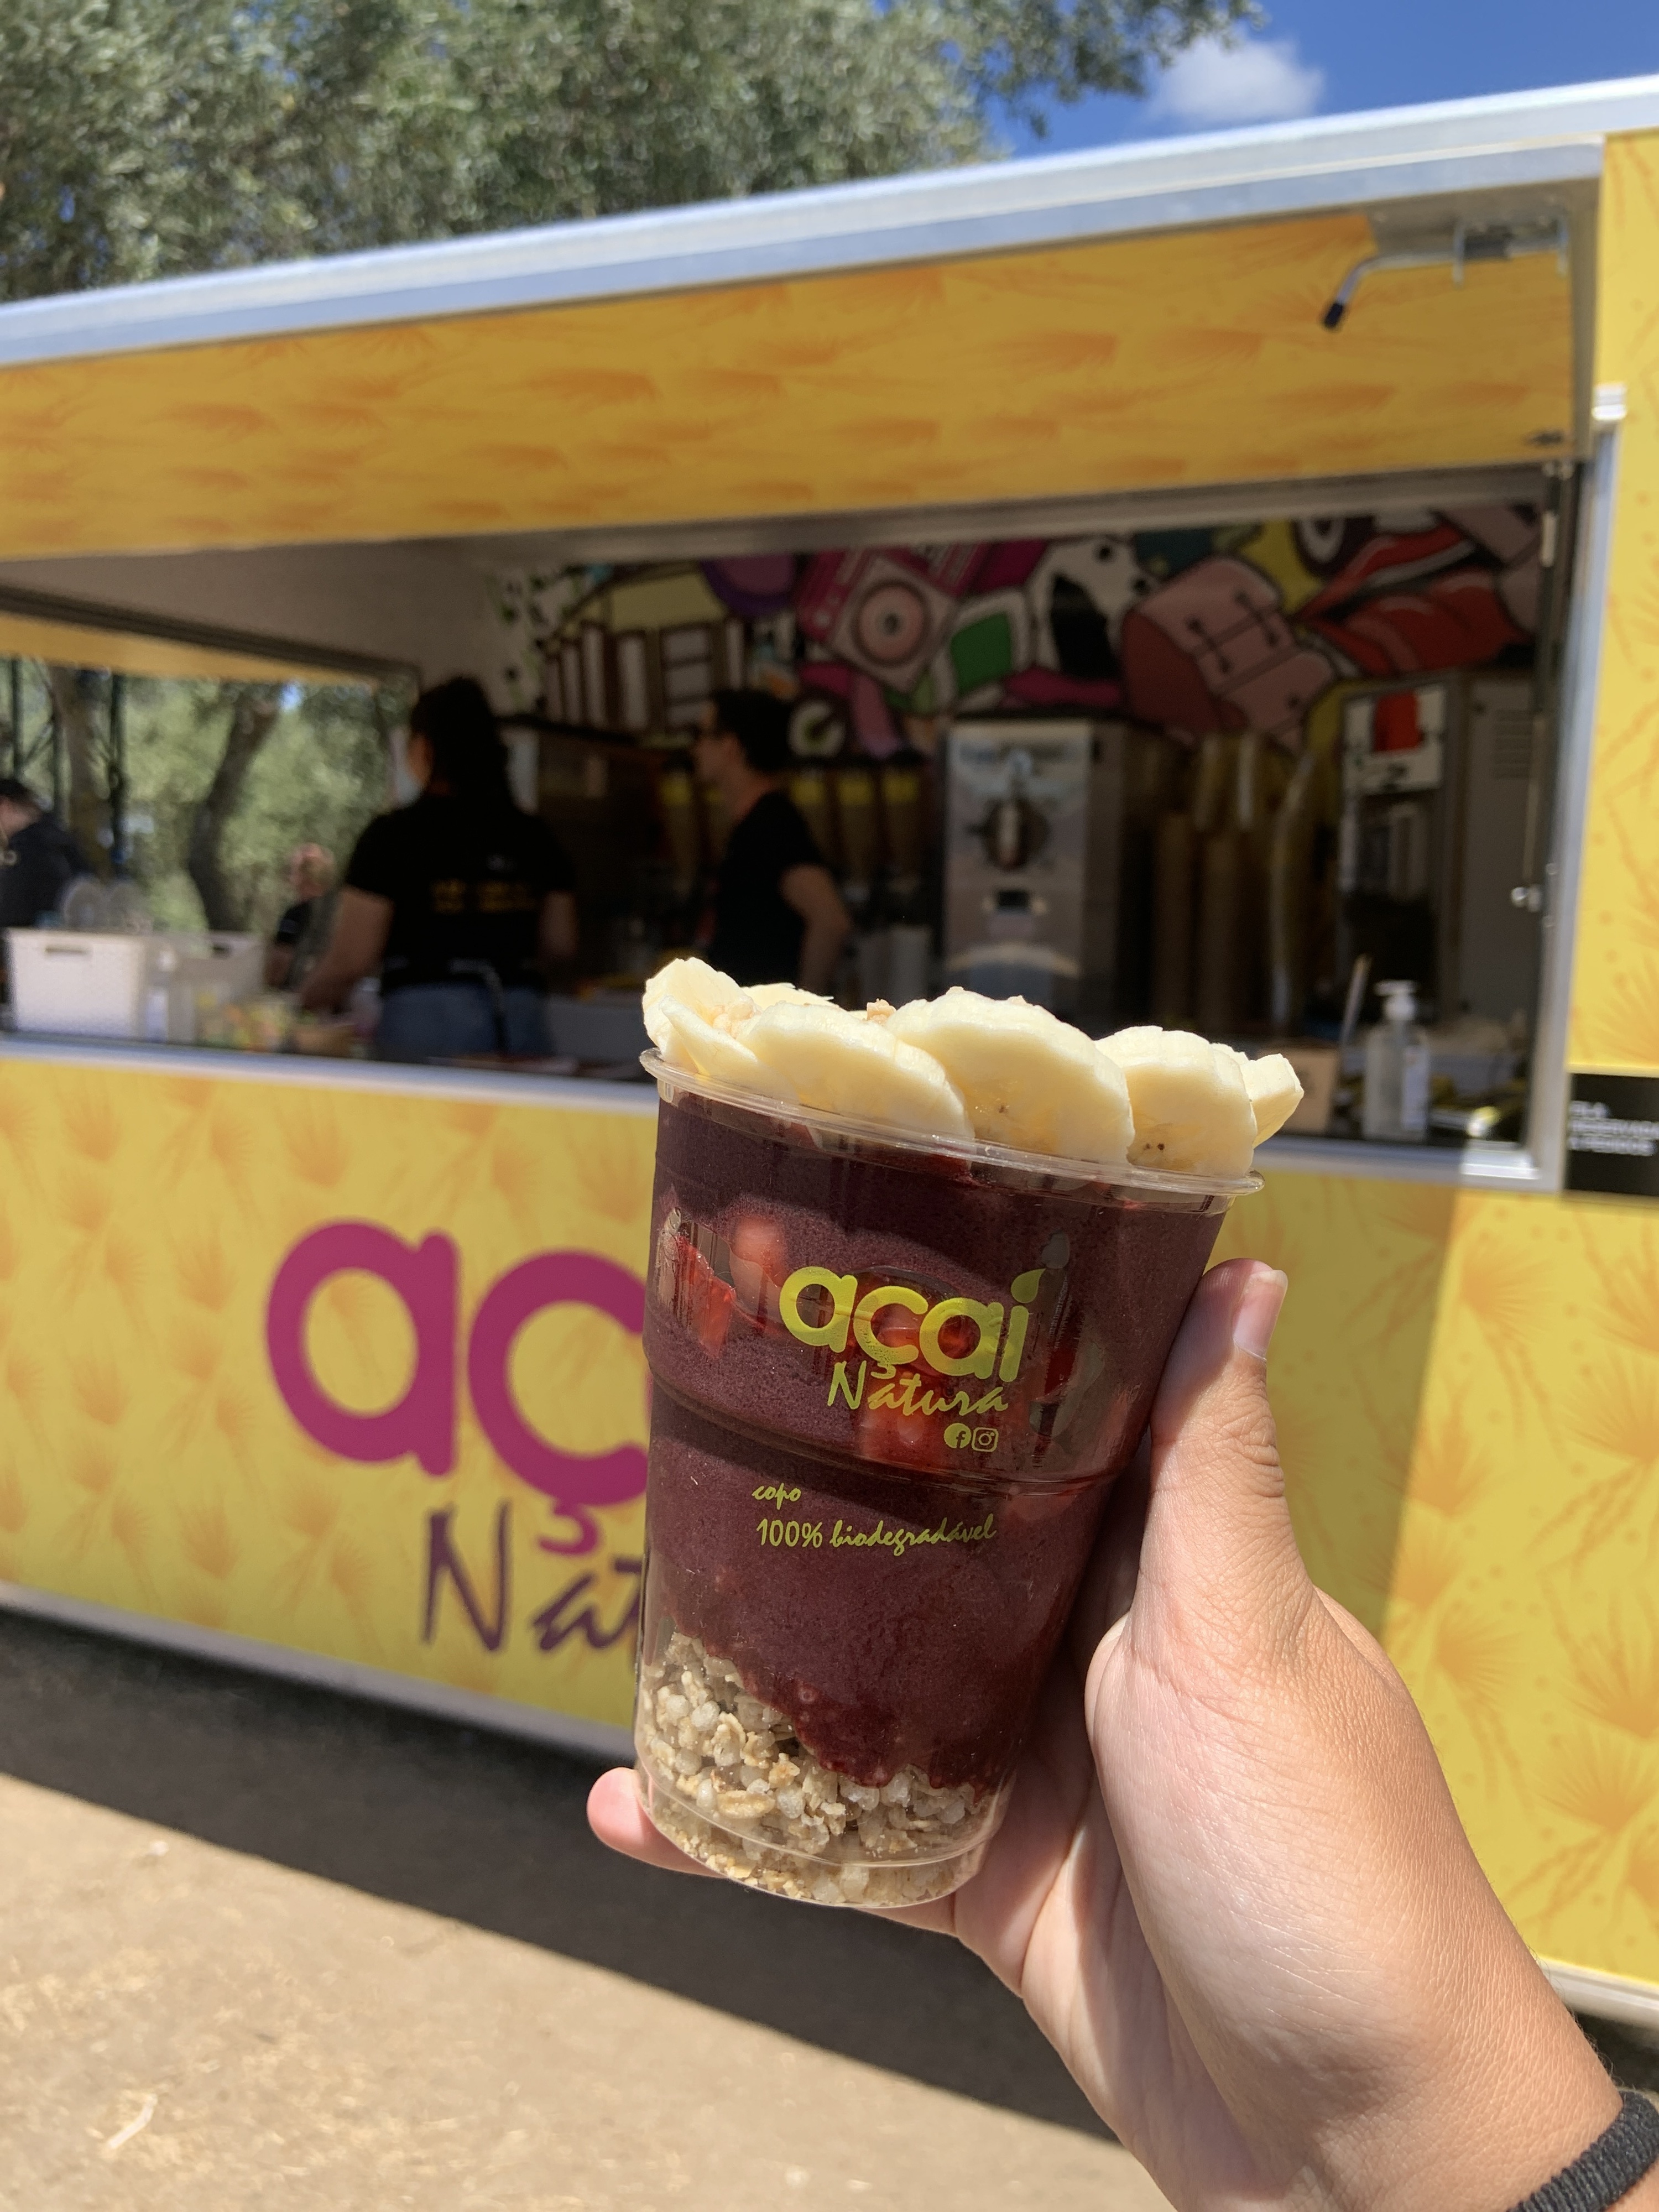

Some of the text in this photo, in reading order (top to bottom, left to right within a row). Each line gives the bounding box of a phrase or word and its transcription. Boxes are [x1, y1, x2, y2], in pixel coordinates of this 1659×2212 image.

[264, 1219, 650, 1554] aç
[827, 1360, 1009, 1416] Natura
[752, 1483, 802, 1510] copo
[757, 1514, 997, 1557] 100% biodegradável
[420, 1495, 643, 1669] Nat
